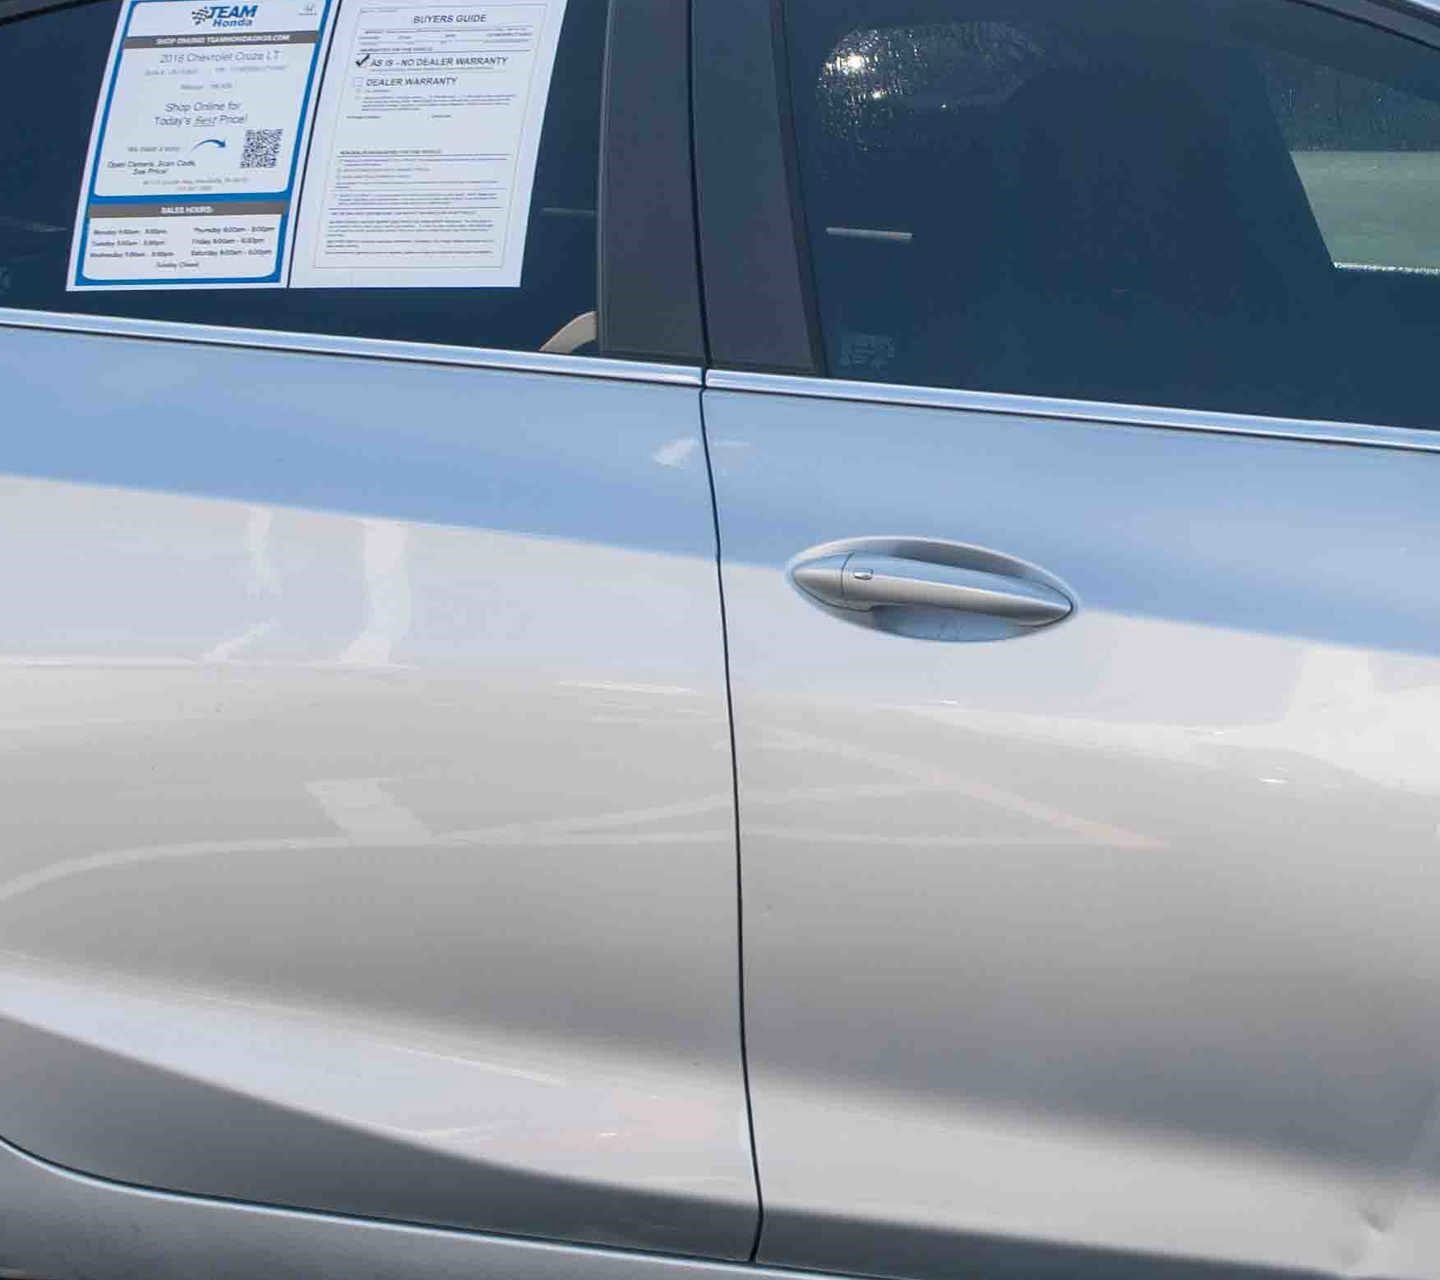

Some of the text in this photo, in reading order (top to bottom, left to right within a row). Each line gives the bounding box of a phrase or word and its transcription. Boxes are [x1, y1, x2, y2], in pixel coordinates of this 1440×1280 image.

[209, 5, 258, 18] TEAM
[212, 19, 253, 27] Honda
[413, 13, 487, 24] BUYERS GUIDE
[371, 58, 383, 67] AS
[385, 58, 394, 66] IS
[401, 58, 415, 66] NO
[416, 57, 454, 66] DEALER
[456, 56, 509, 66] WARRANTY
[366, 77, 458, 87] DEALER WARRANTY
